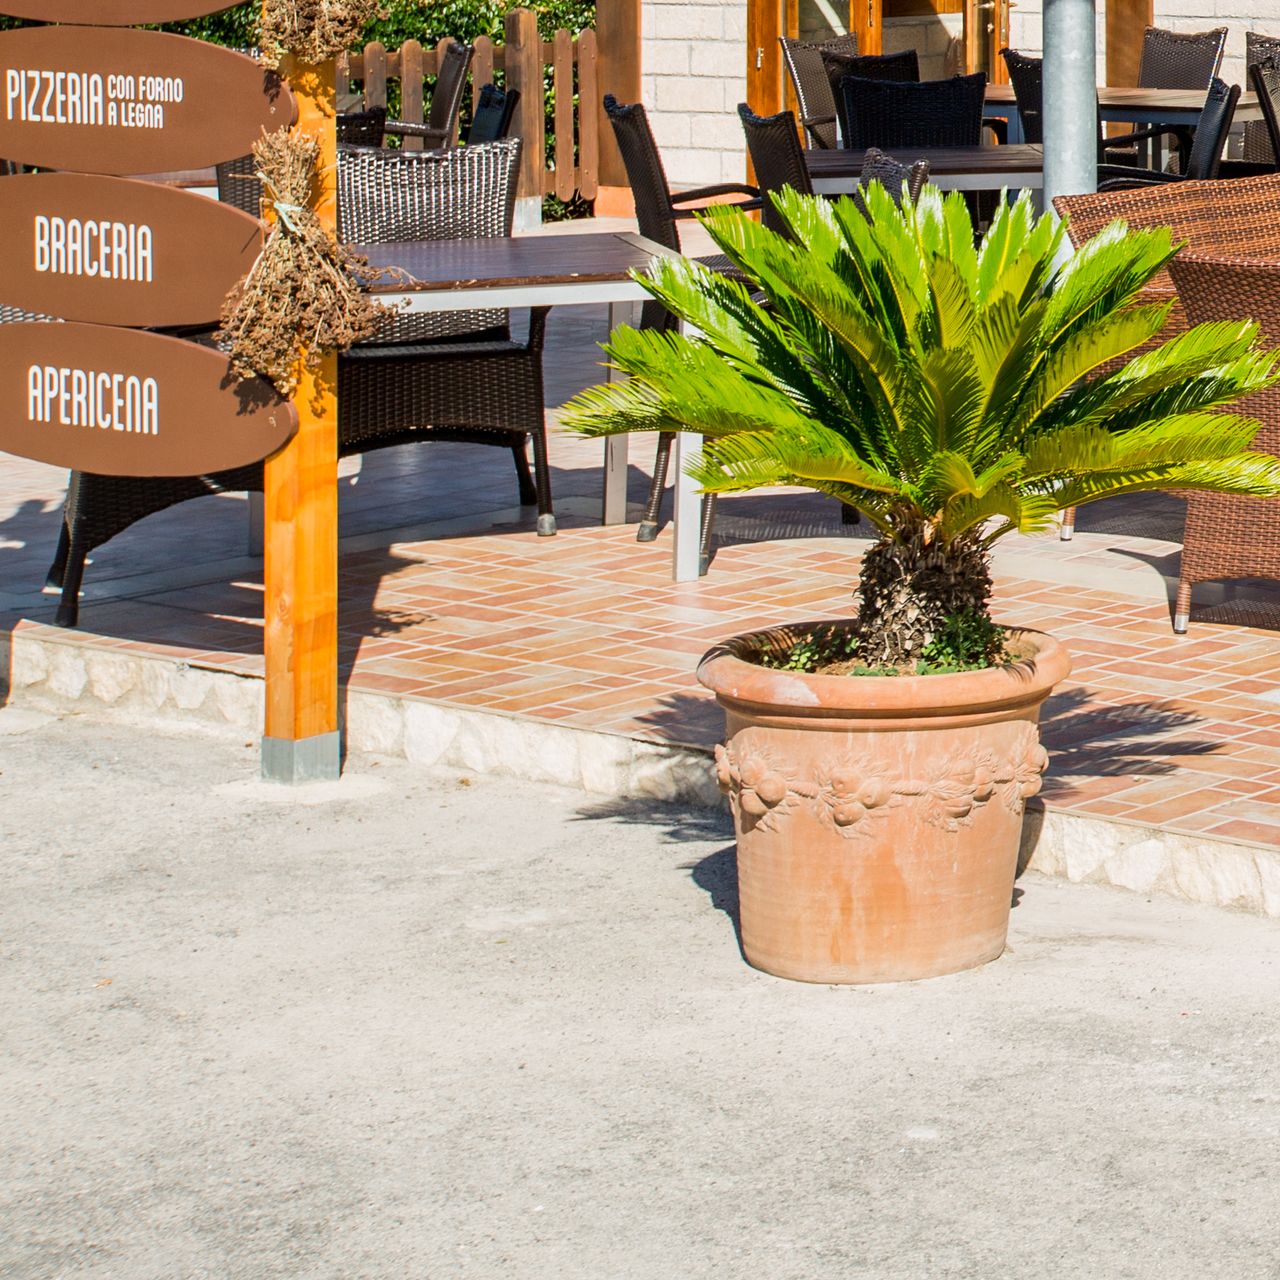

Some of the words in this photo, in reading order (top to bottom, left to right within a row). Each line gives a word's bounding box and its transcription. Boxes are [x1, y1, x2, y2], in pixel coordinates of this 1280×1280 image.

[6, 69, 104, 125] PIZZERIA
[107, 74, 135, 100] CON
[138, 76, 183, 103] FORNO
[107, 101, 118, 126] A
[121, 102, 164, 129] LEGNA
[34, 215, 153, 283] BRACERIA
[28, 365, 159, 435] APERICENA
